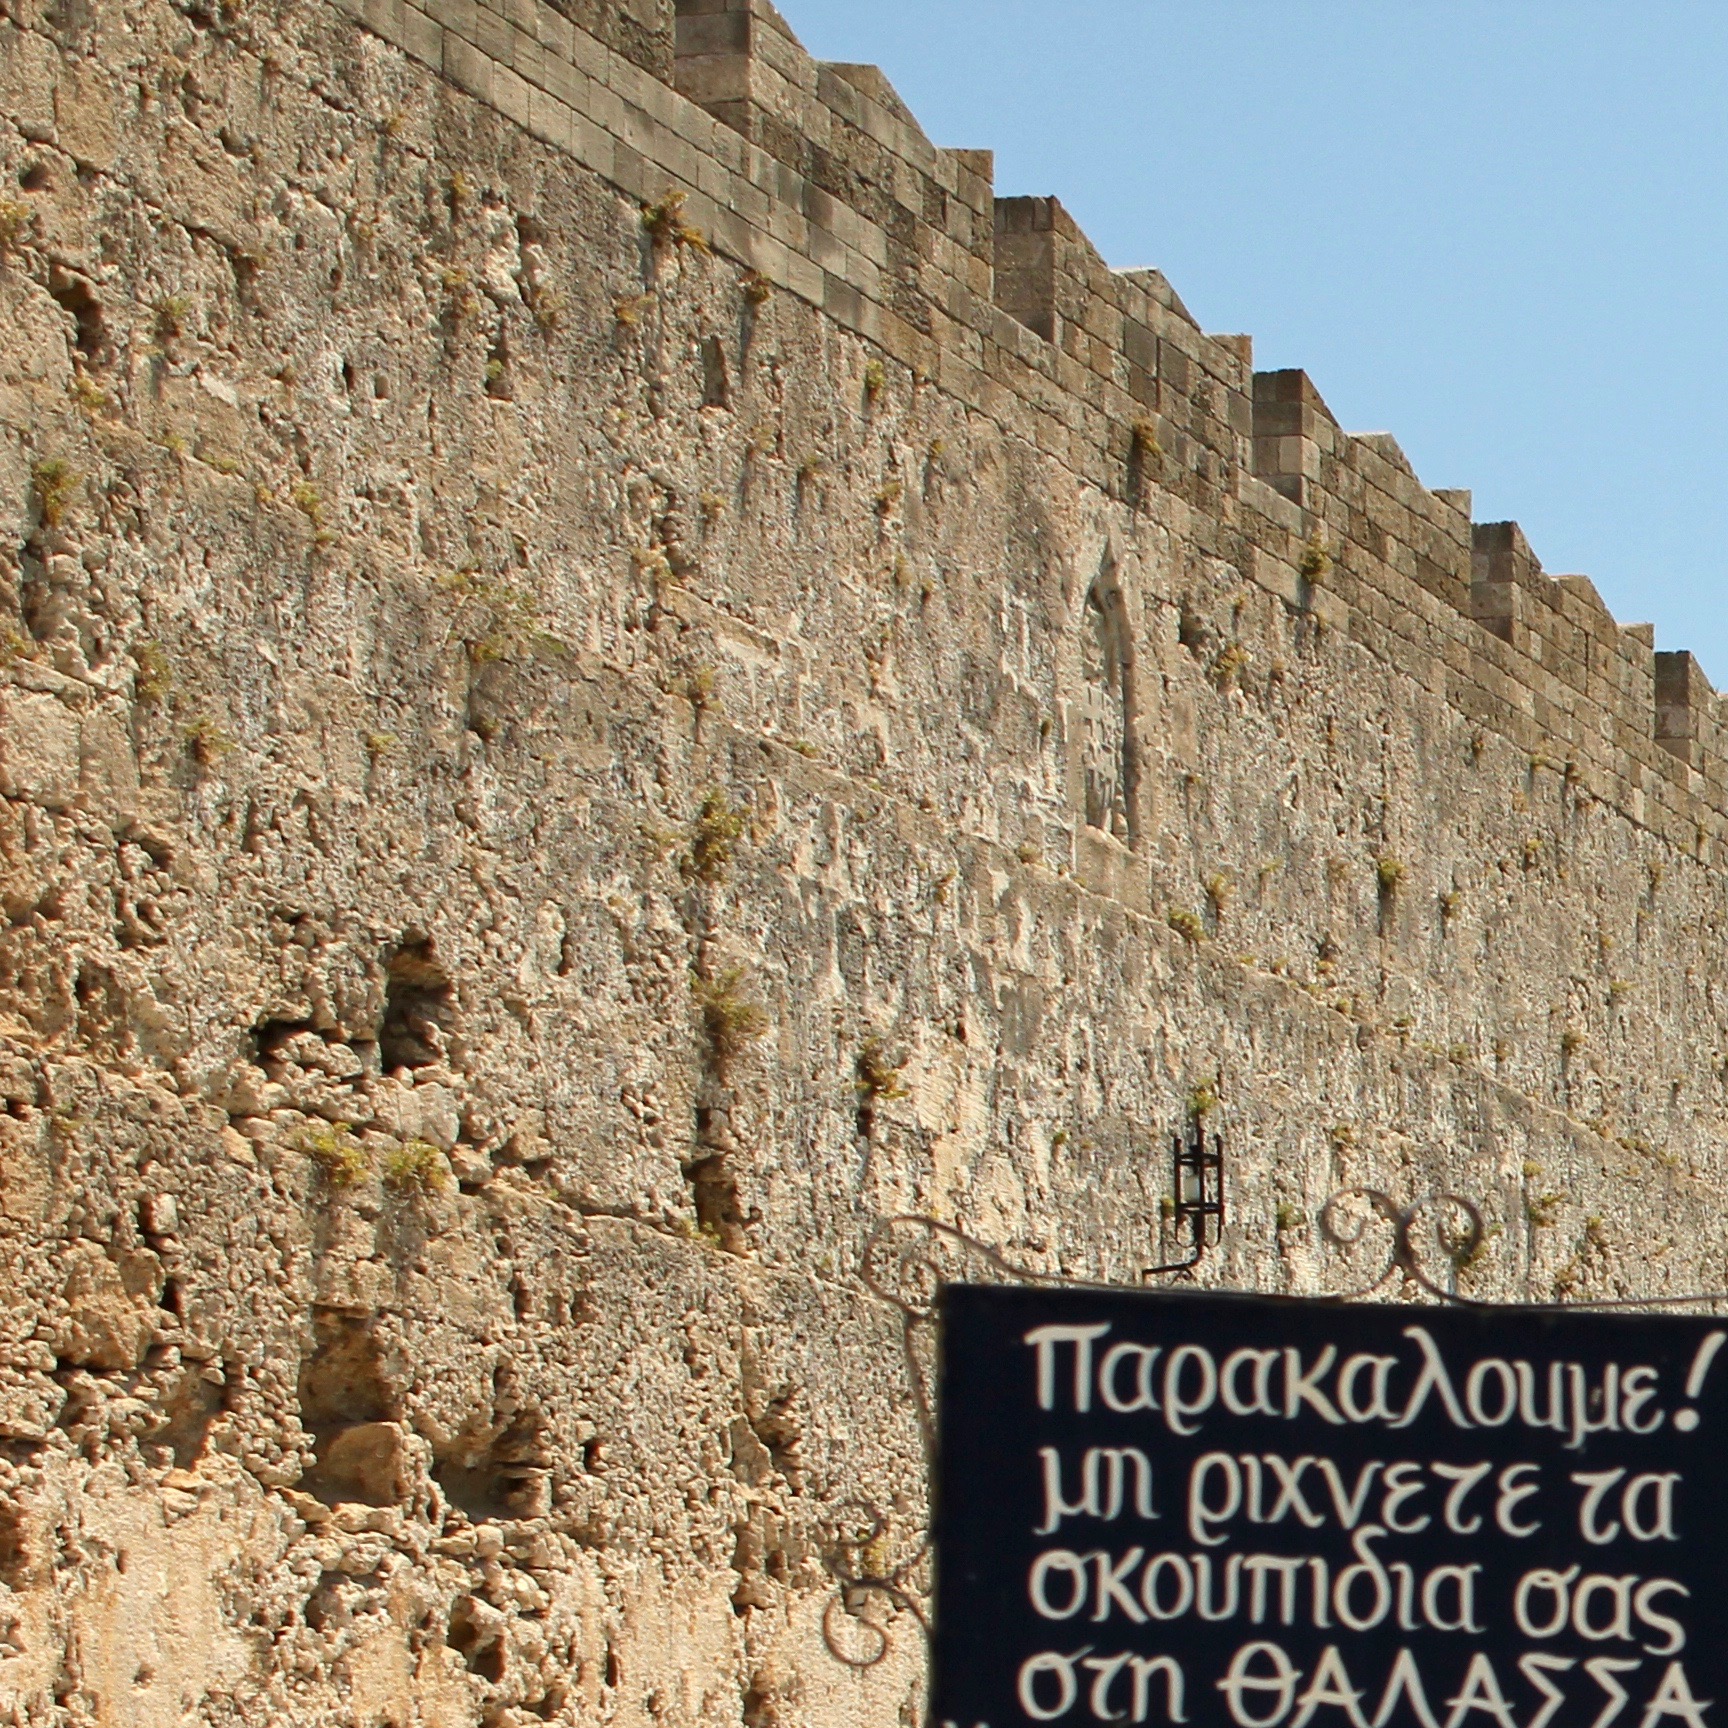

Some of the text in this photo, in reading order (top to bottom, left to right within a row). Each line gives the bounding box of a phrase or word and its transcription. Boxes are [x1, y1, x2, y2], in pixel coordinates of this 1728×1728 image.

[1025, 1323, 1726, 1449] Παρακαλουμε!
[1035, 1447, 1680, 1546] μη ριχνετε τα
[1030, 1524, 1689, 1656] σκουπιδια σας
[1019, 1652, 1184, 1723] στη
